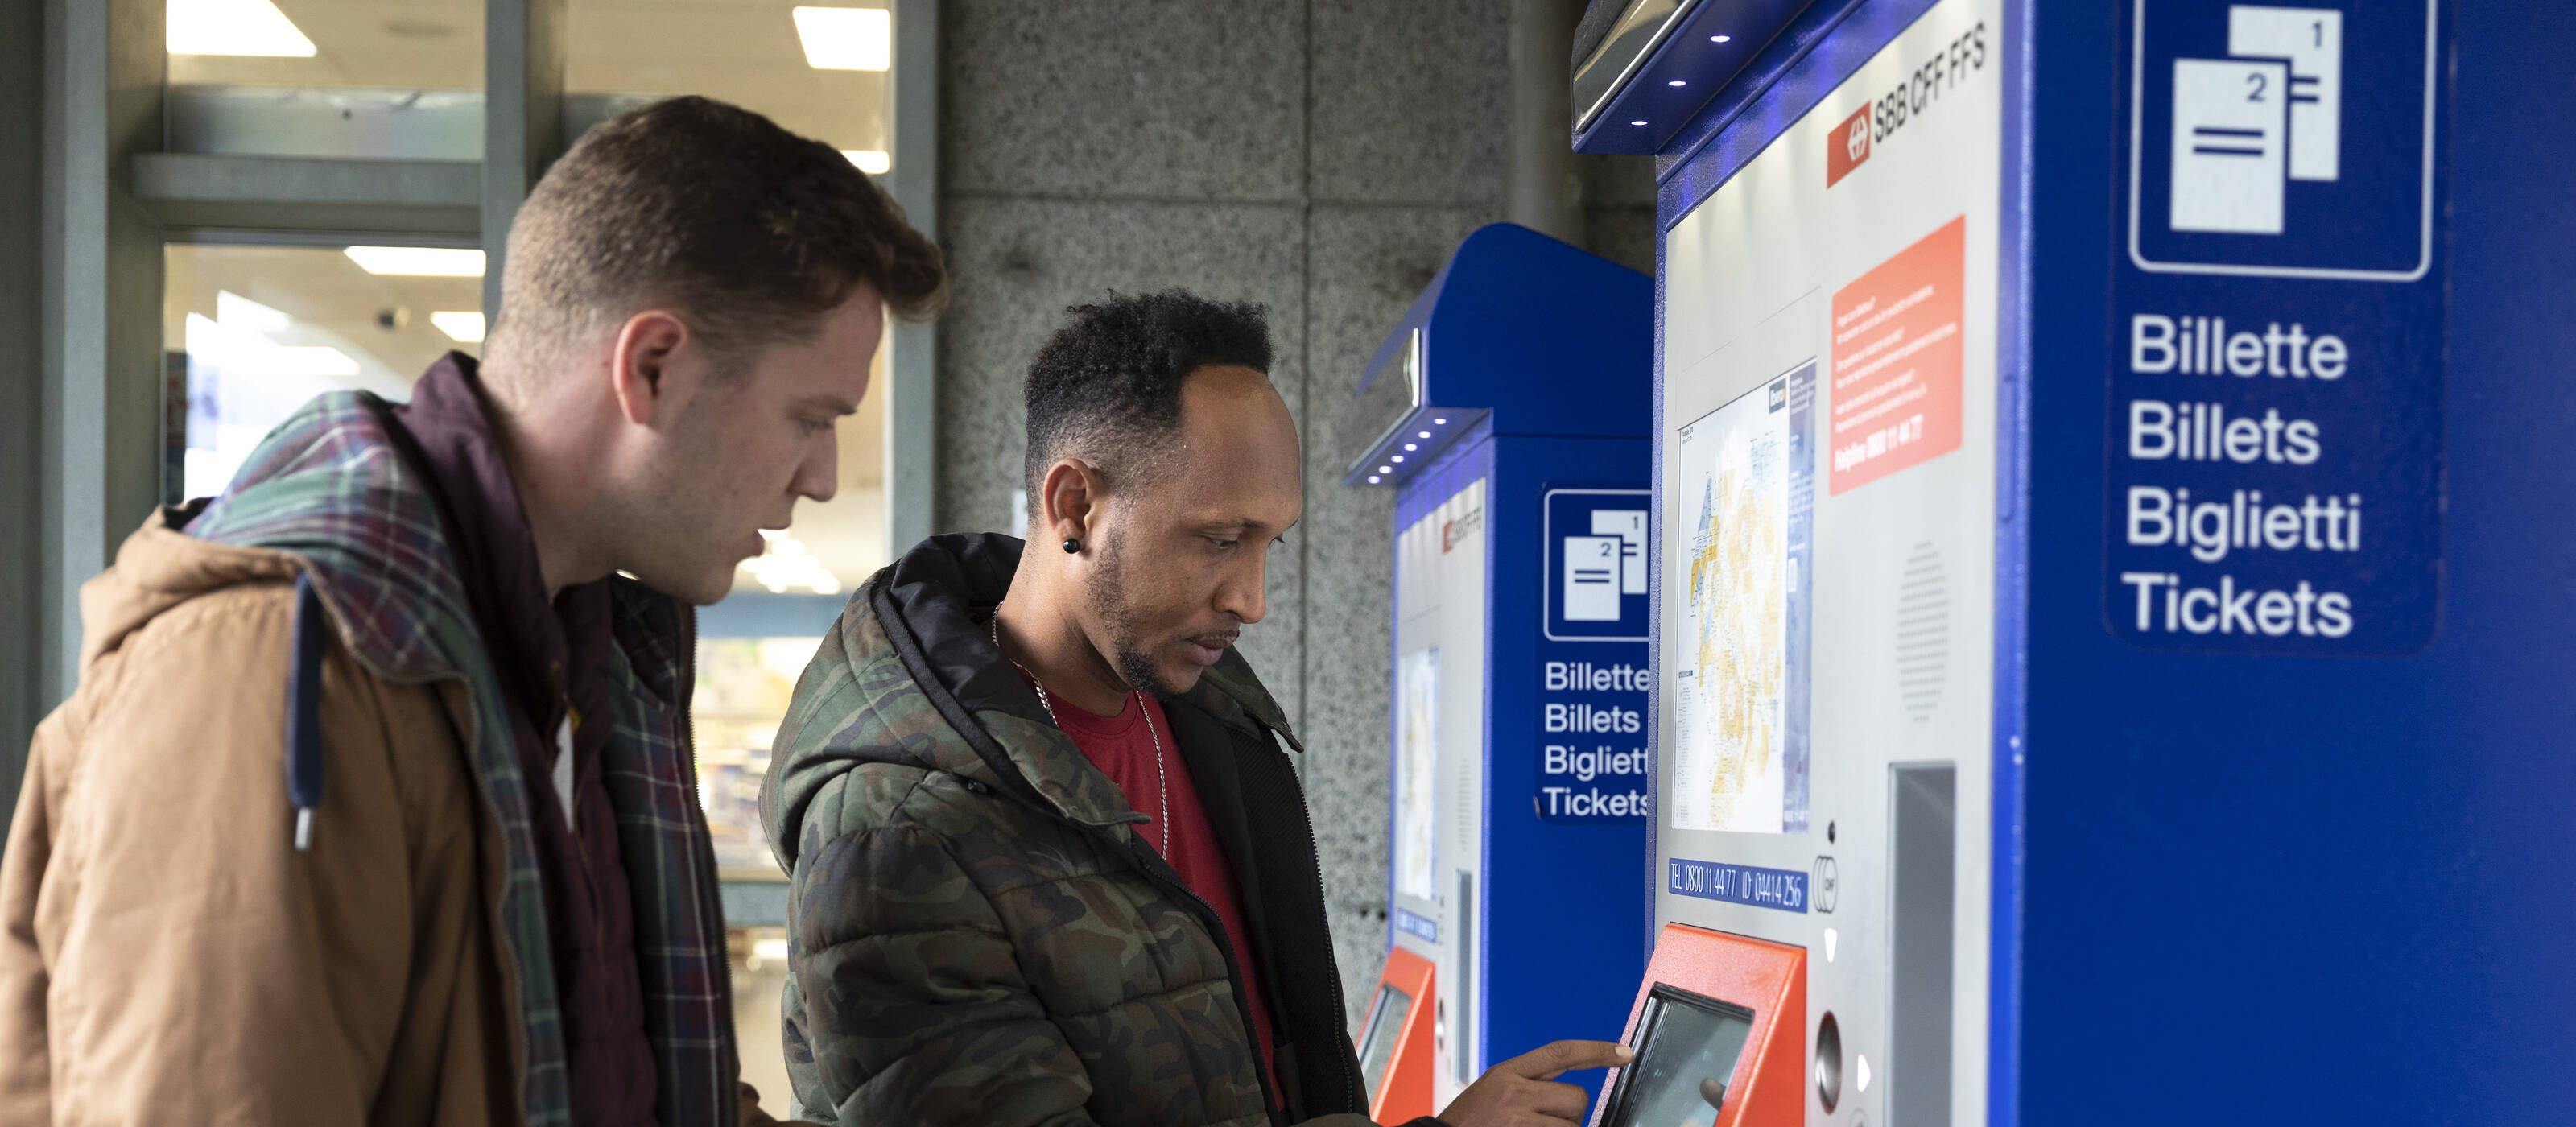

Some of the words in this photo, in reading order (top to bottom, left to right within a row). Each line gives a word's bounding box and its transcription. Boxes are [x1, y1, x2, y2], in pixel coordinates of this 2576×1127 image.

[2311, 20, 2323, 48] 1
[1875, 82, 1906, 144] SBB
[1912, 52, 1944, 115] CFF
[1950, 21, 1986, 89] FFS
[2246, 72, 2268, 103] 2
[2131, 314, 2348, 380] Billette
[2129, 400, 2321, 464] Billets
[1632, 515, 1640, 530] 1
[2128, 486, 2360, 562] Biglietti
[1600, 542, 1612, 558] 2
[2121, 572, 2353, 638] Tickets
[1545, 661, 1649, 691] Billette
[1545, 703, 1641, 733] Billets
[1545, 745, 1648, 782] Bigliett
[1671, 863, 1682, 890] TEL
[1685, 865, 1703, 893] 0800
[1706, 867, 1712, 894] 11
[1714, 869, 1724, 895] 44
[1727, 869, 1736, 898] 77
[1742, 871, 1752, 899] ID
[1755, 872, 1781, 904] 04414
[1783, 875, 1802, 908] 256
